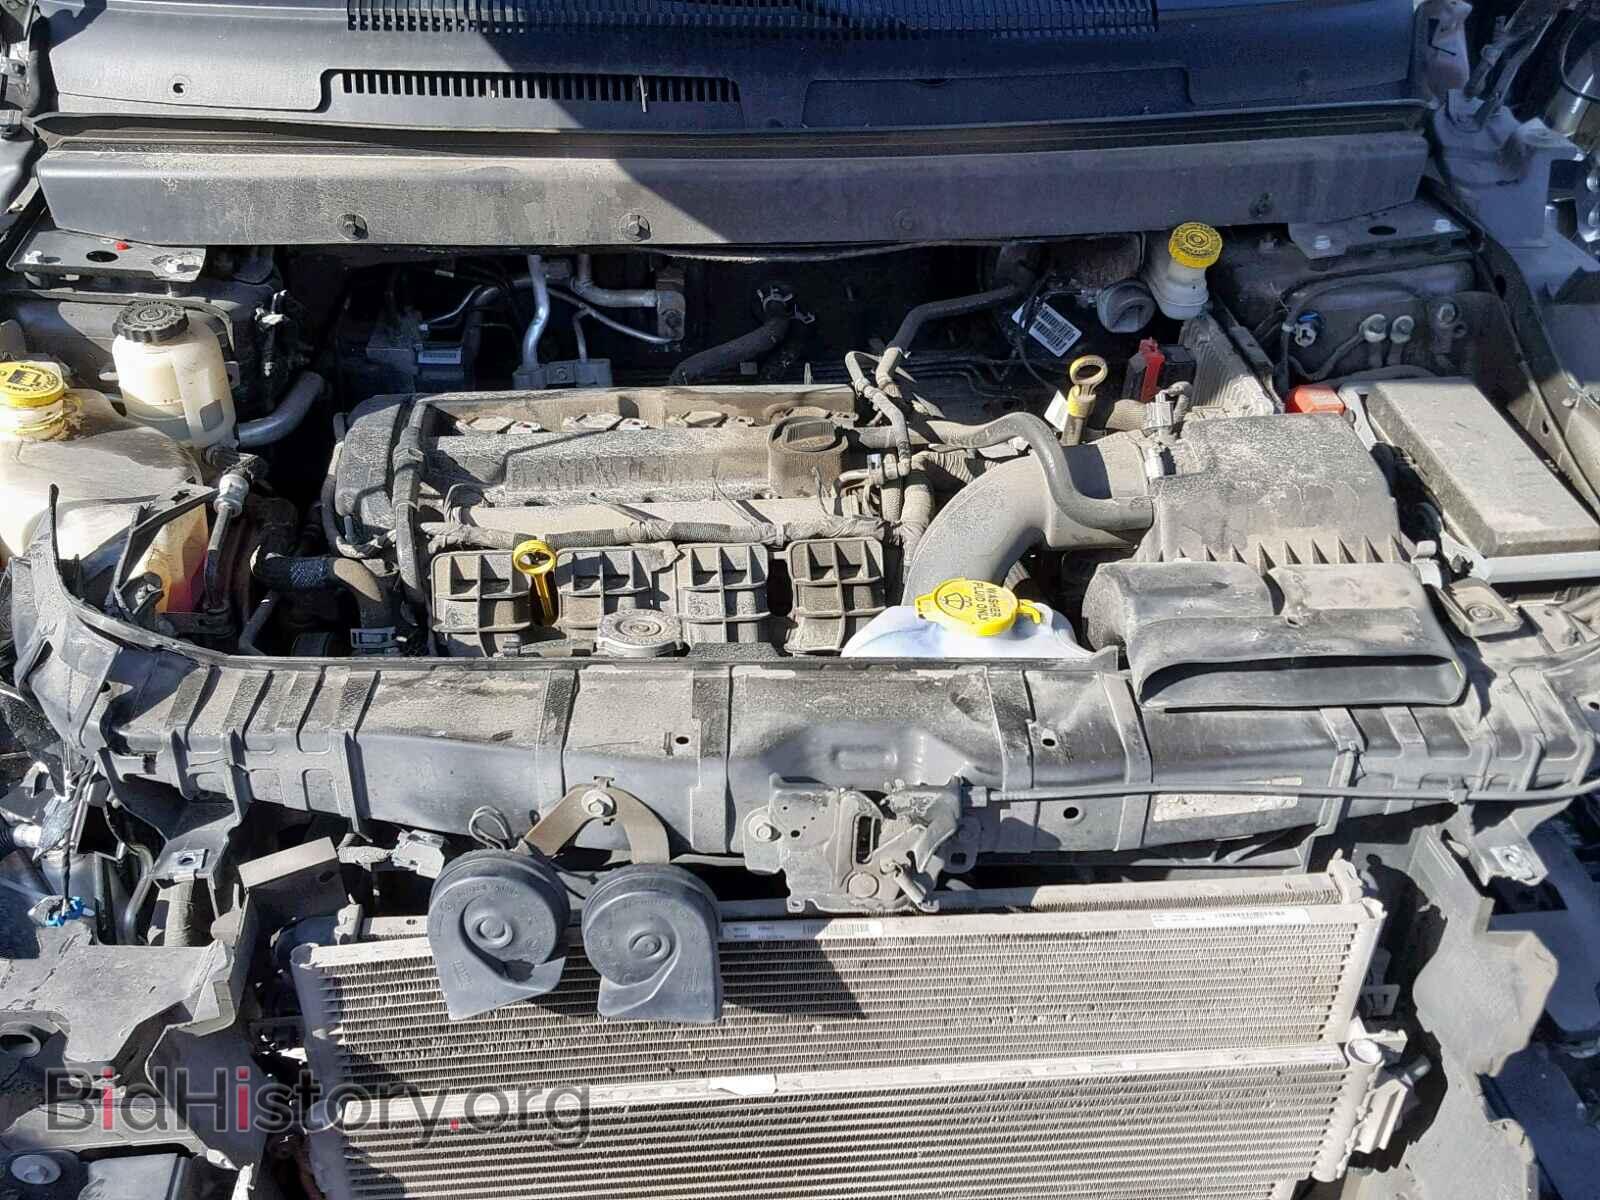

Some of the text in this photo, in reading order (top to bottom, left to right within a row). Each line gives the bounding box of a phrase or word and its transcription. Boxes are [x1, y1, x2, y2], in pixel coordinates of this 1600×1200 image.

[973, 582, 989, 620] FLUID ONLY
[986, 587, 1001, 617] WASHER
